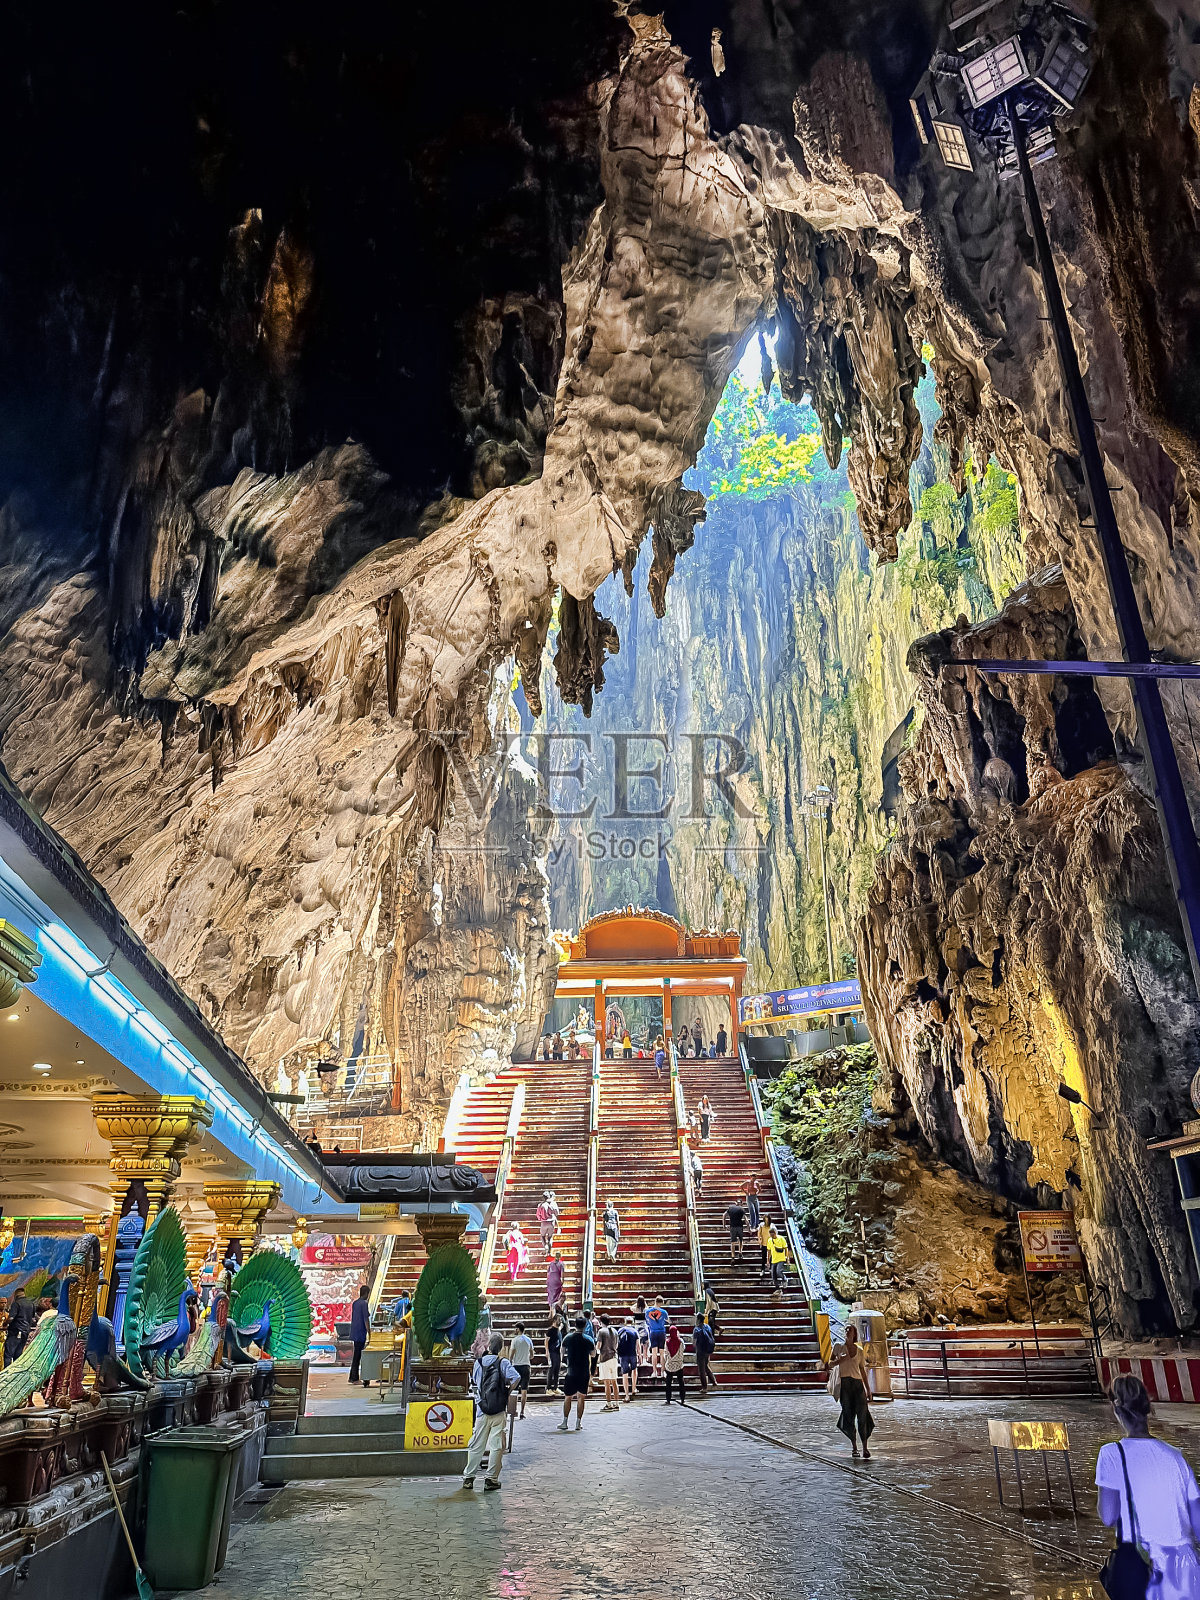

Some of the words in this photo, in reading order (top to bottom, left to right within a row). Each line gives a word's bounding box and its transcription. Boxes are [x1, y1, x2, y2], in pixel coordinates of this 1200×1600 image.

[777, 1005, 790, 1013] SRI
[413, 1436, 430, 1447] NO
[433, 1434, 465, 1446] SHOE
